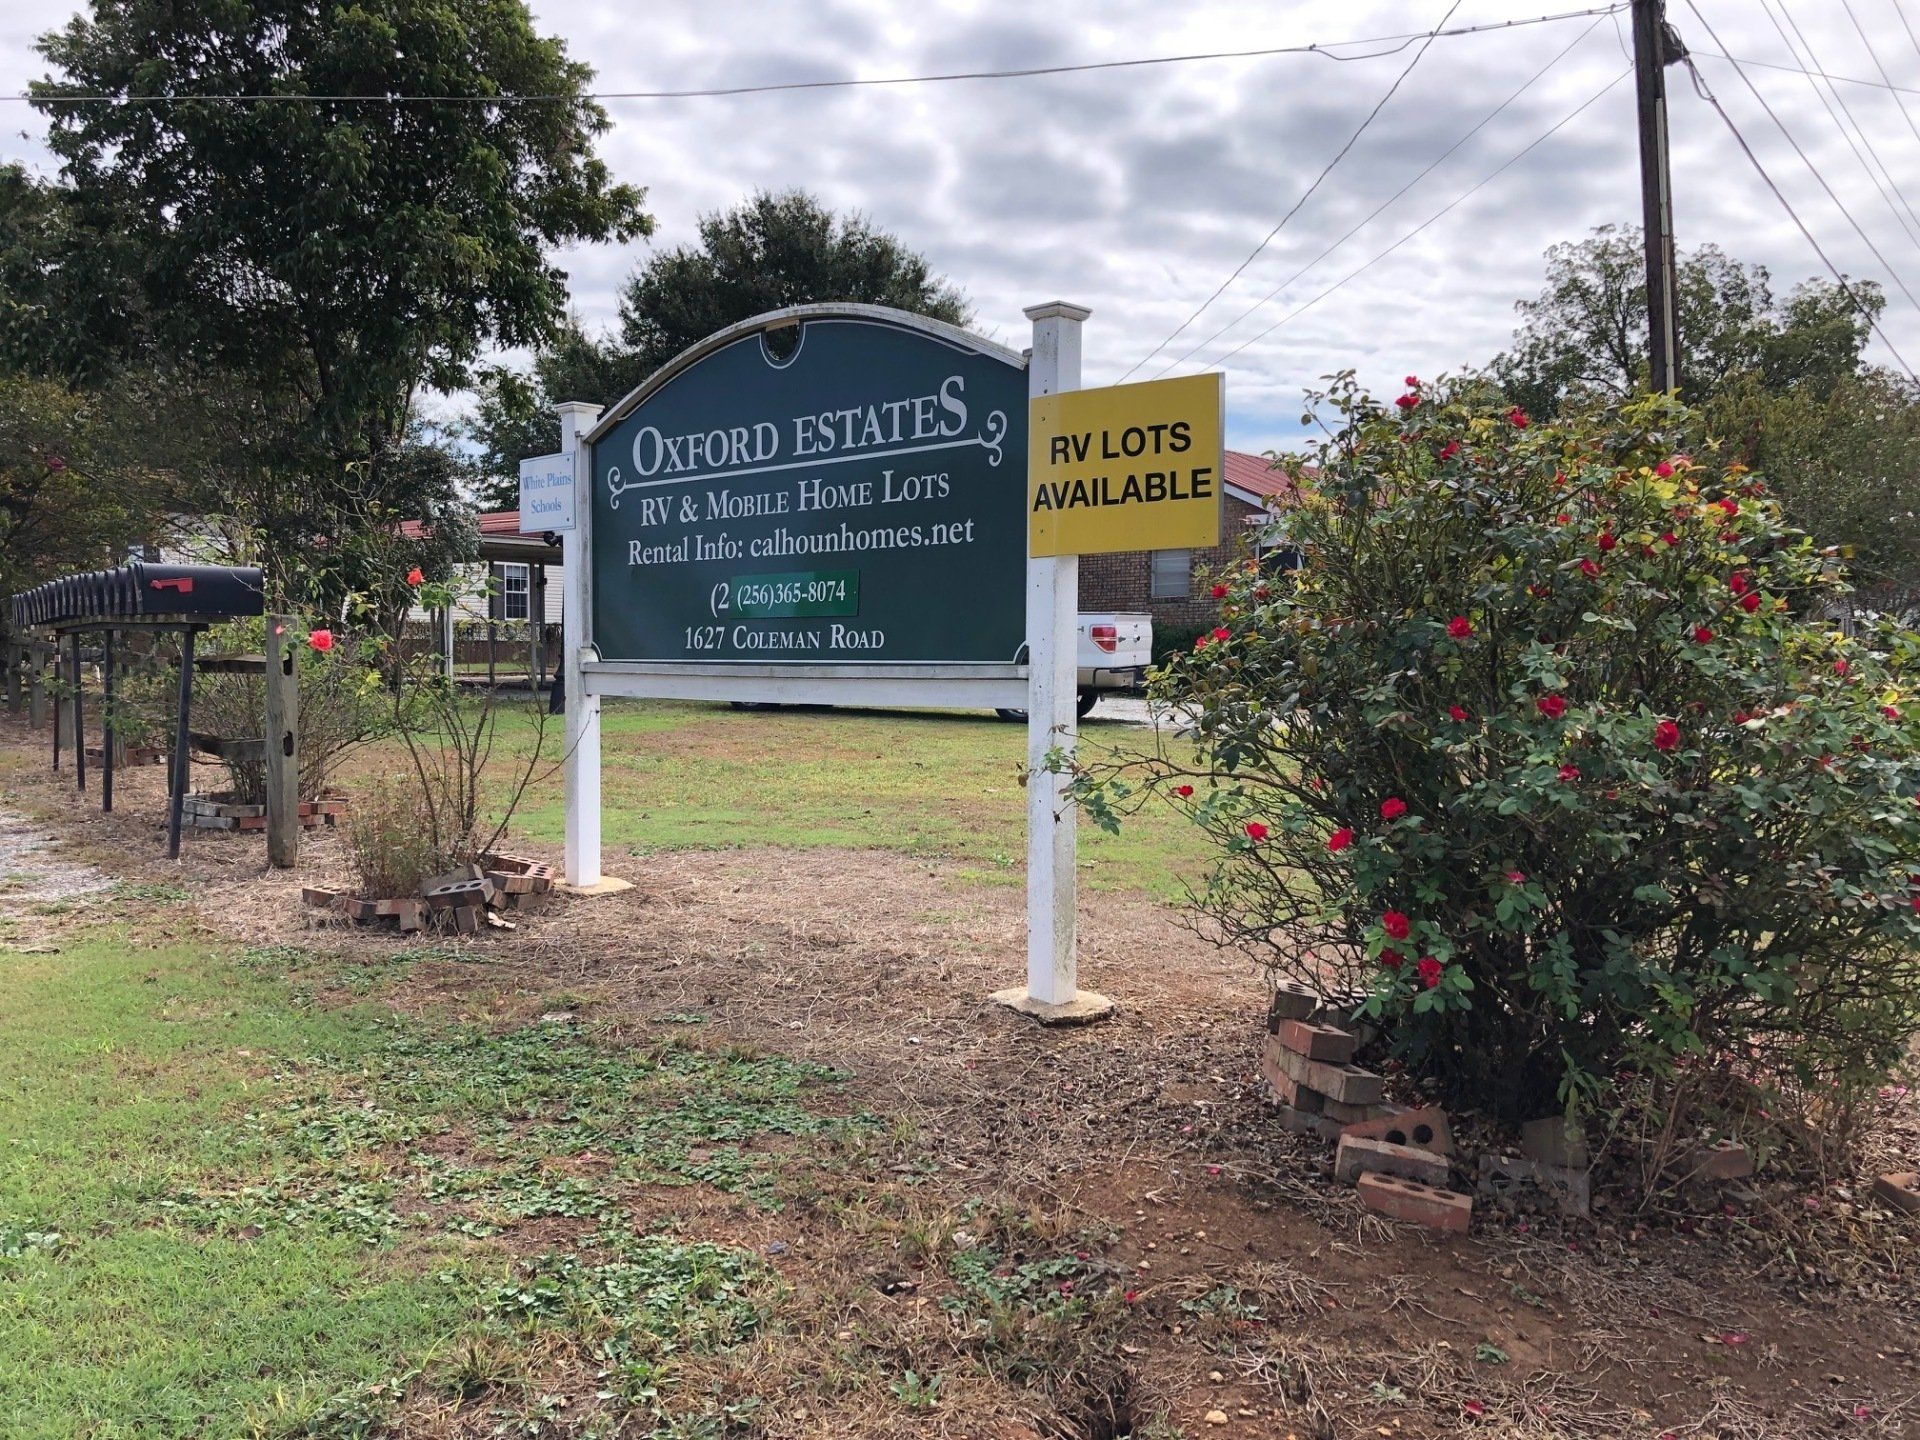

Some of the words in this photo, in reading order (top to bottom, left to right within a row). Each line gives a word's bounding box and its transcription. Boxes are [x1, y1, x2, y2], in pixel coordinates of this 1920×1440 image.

[633, 426, 779, 476] OXFORD
[792, 375, 968, 456] ESTATES
[1051, 432, 1092, 465] RV
[1102, 421, 1192, 460] LOTS
[523, 475, 545, 491] White
[546, 472, 572, 488] Plains
[640, 495, 674, 527] RV
[679, 495, 699, 524] &
[705, 489, 790, 521] MOBILE
[797, 478, 873, 512] HOME
[881, 469, 950, 504] LOTS
[1033, 467, 1213, 513] AVAILABLE
[530, 497, 562, 514] Schools
[627, 535, 690, 566] Rental
[694, 532, 744, 562] Info:
[750, 517, 975, 558] calhounhomes.net
[737, 579, 847, 612] (256)365-8074
[685, 626, 726, 650] 1627
[732, 625, 821, 650] COLEMAN
[829, 623, 885, 650] ROAD
